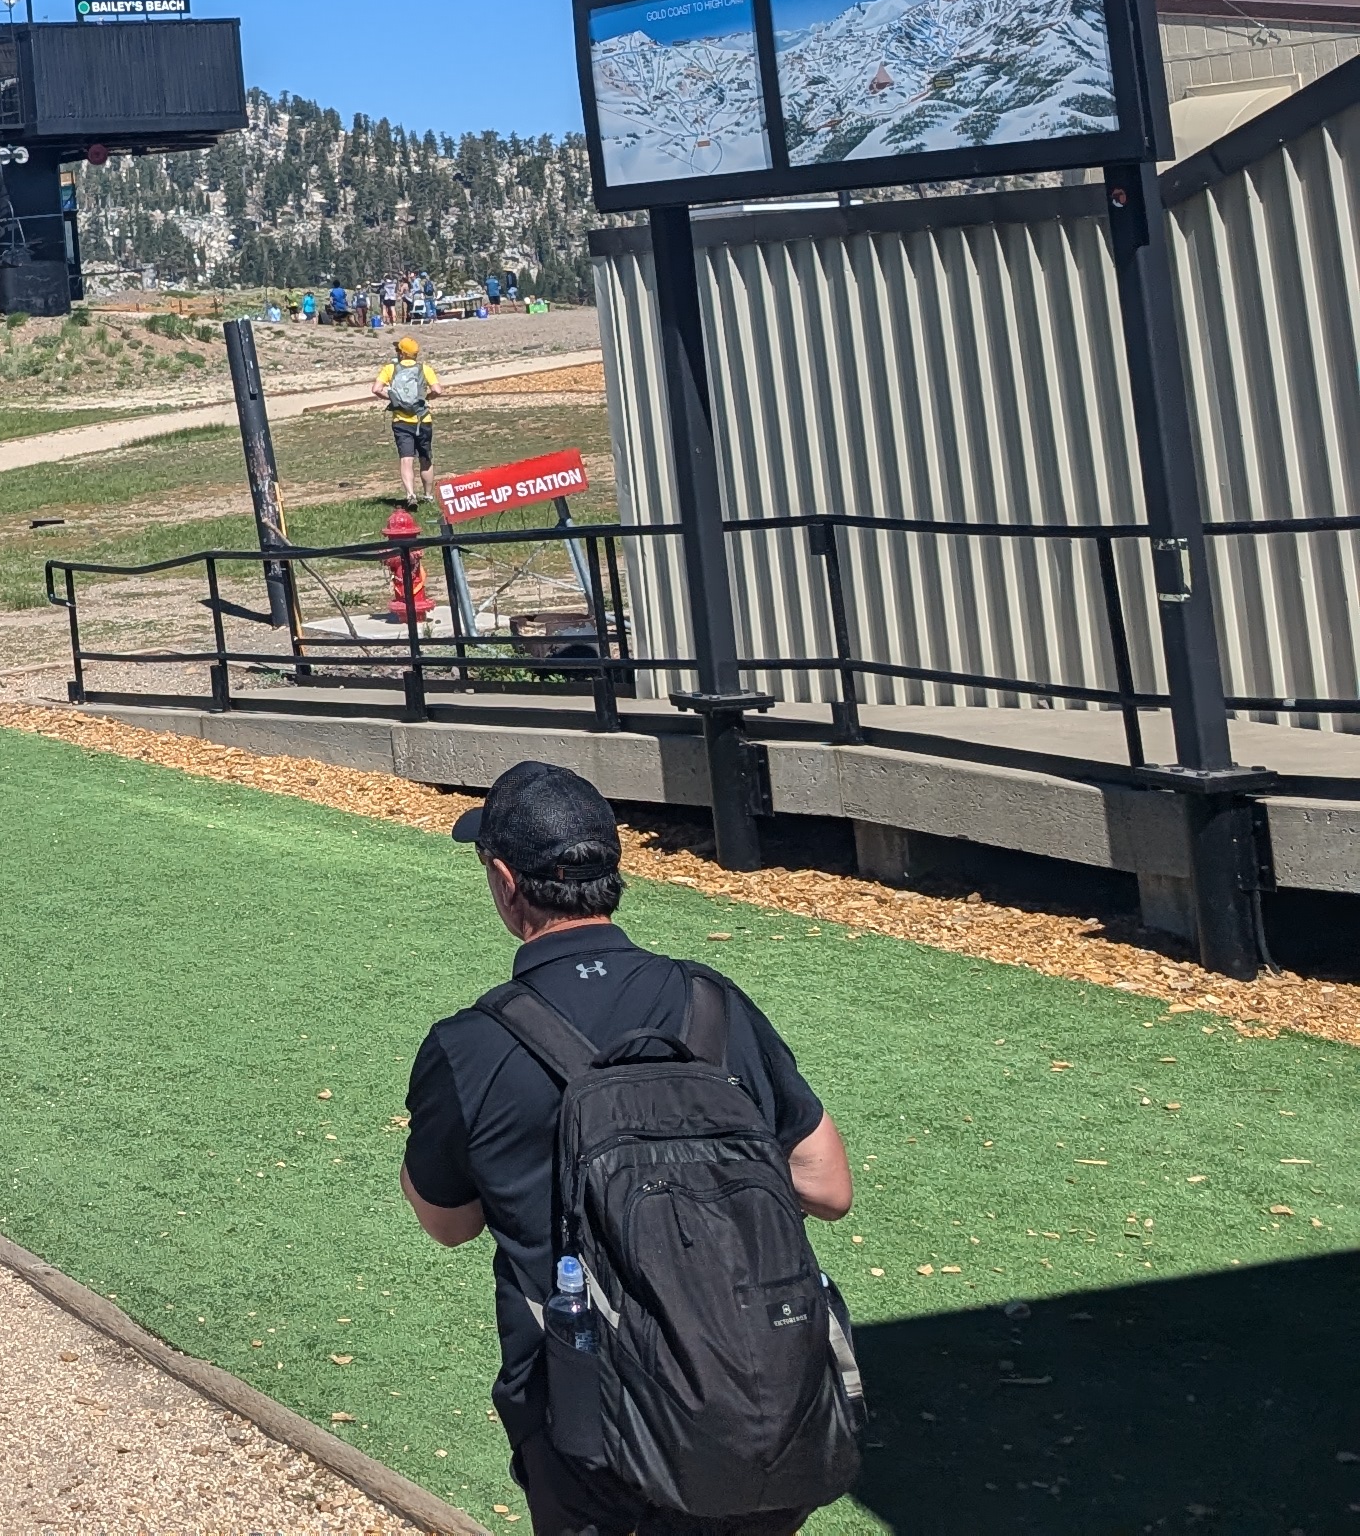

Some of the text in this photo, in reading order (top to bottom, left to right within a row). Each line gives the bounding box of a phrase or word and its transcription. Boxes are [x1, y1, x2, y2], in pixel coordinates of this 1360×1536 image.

[92, 0, 185, 13] BAILEY'S BEACH
[646, 8, 667, 22] GOLD
[667, 3, 691, 18] COAST
[692, 2, 703, 12] TO
[444, 467, 582, 515] TUNE-UP STATION
[454, 480, 482, 493] TOYOTA
